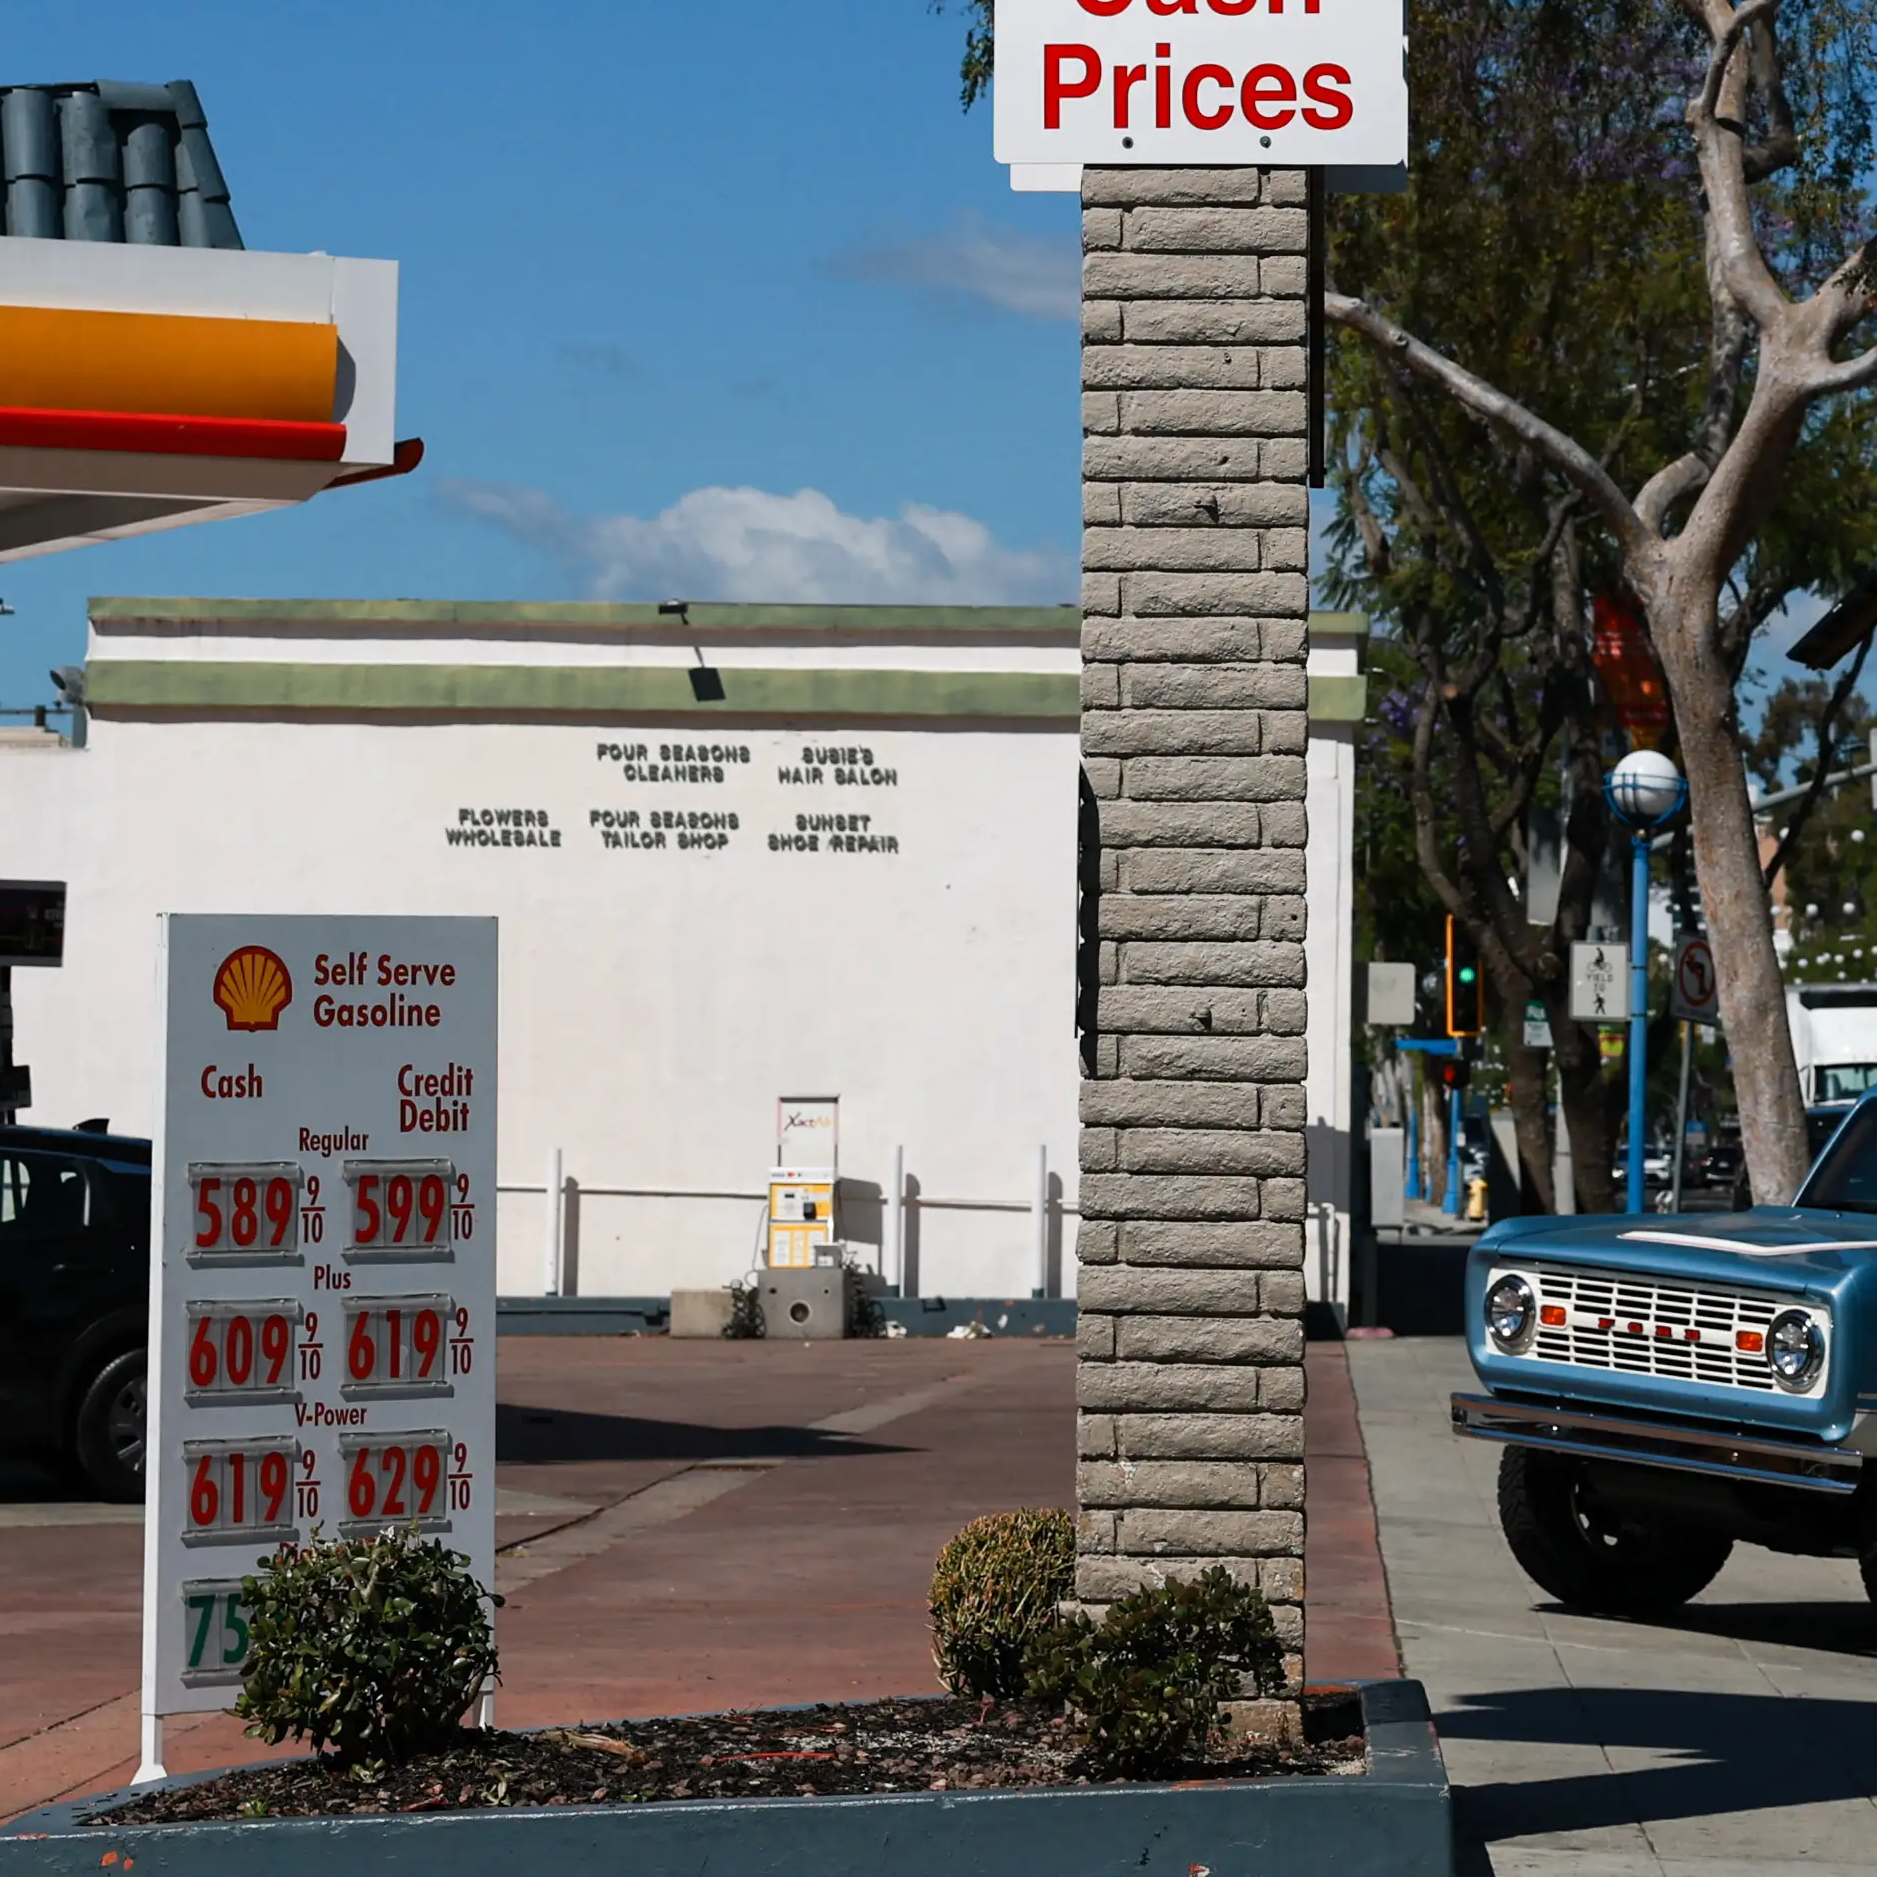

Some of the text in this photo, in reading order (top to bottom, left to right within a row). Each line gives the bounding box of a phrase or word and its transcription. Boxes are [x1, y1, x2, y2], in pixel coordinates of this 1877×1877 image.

[1043, 42, 1354, 131] Prices
[597, 743, 751, 764] FOUR SEASONS
[801, 746, 874, 766] SUSIE'S
[623, 764, 725, 784] CLEANERS
[778, 767, 898, 786] HAIR SALON
[458, 808, 549, 828] FLOWERS
[590, 810, 740, 831] FOUR SEASONS
[795, 814, 872, 833] SUNSET
[445, 828, 562, 848] WHOLESALE
[601, 830, 730, 851] TAILOR SHOP
[768, 833, 900, 854] SHOE REPAIR
[315, 954, 455, 986] Self Serve
[1586, 972, 1614, 983] YIELD
[315, 995, 440, 1027] Gasoline
[202, 1066, 263, 1098] Cash
[399, 1065, 473, 1097] Credit
[401, 1099, 469, 1132] Debit
[300, 1127, 369, 1157] Regular
[195, 1176, 294, 1248] 589
[354, 1174, 446, 1244] 599
[314, 1265, 351, 1290] Plus
[1598, 1317, 1701, 1342] FORD
[188, 1314, 291, 1387] 609
[347, 1310, 442, 1380] 619
[295, 1403, 367, 1427] V-Power
[189, 1451, 289, 1527] 619
[348, 1443, 442, 1519] 629
[188, 1593, 249, 1668] 75
